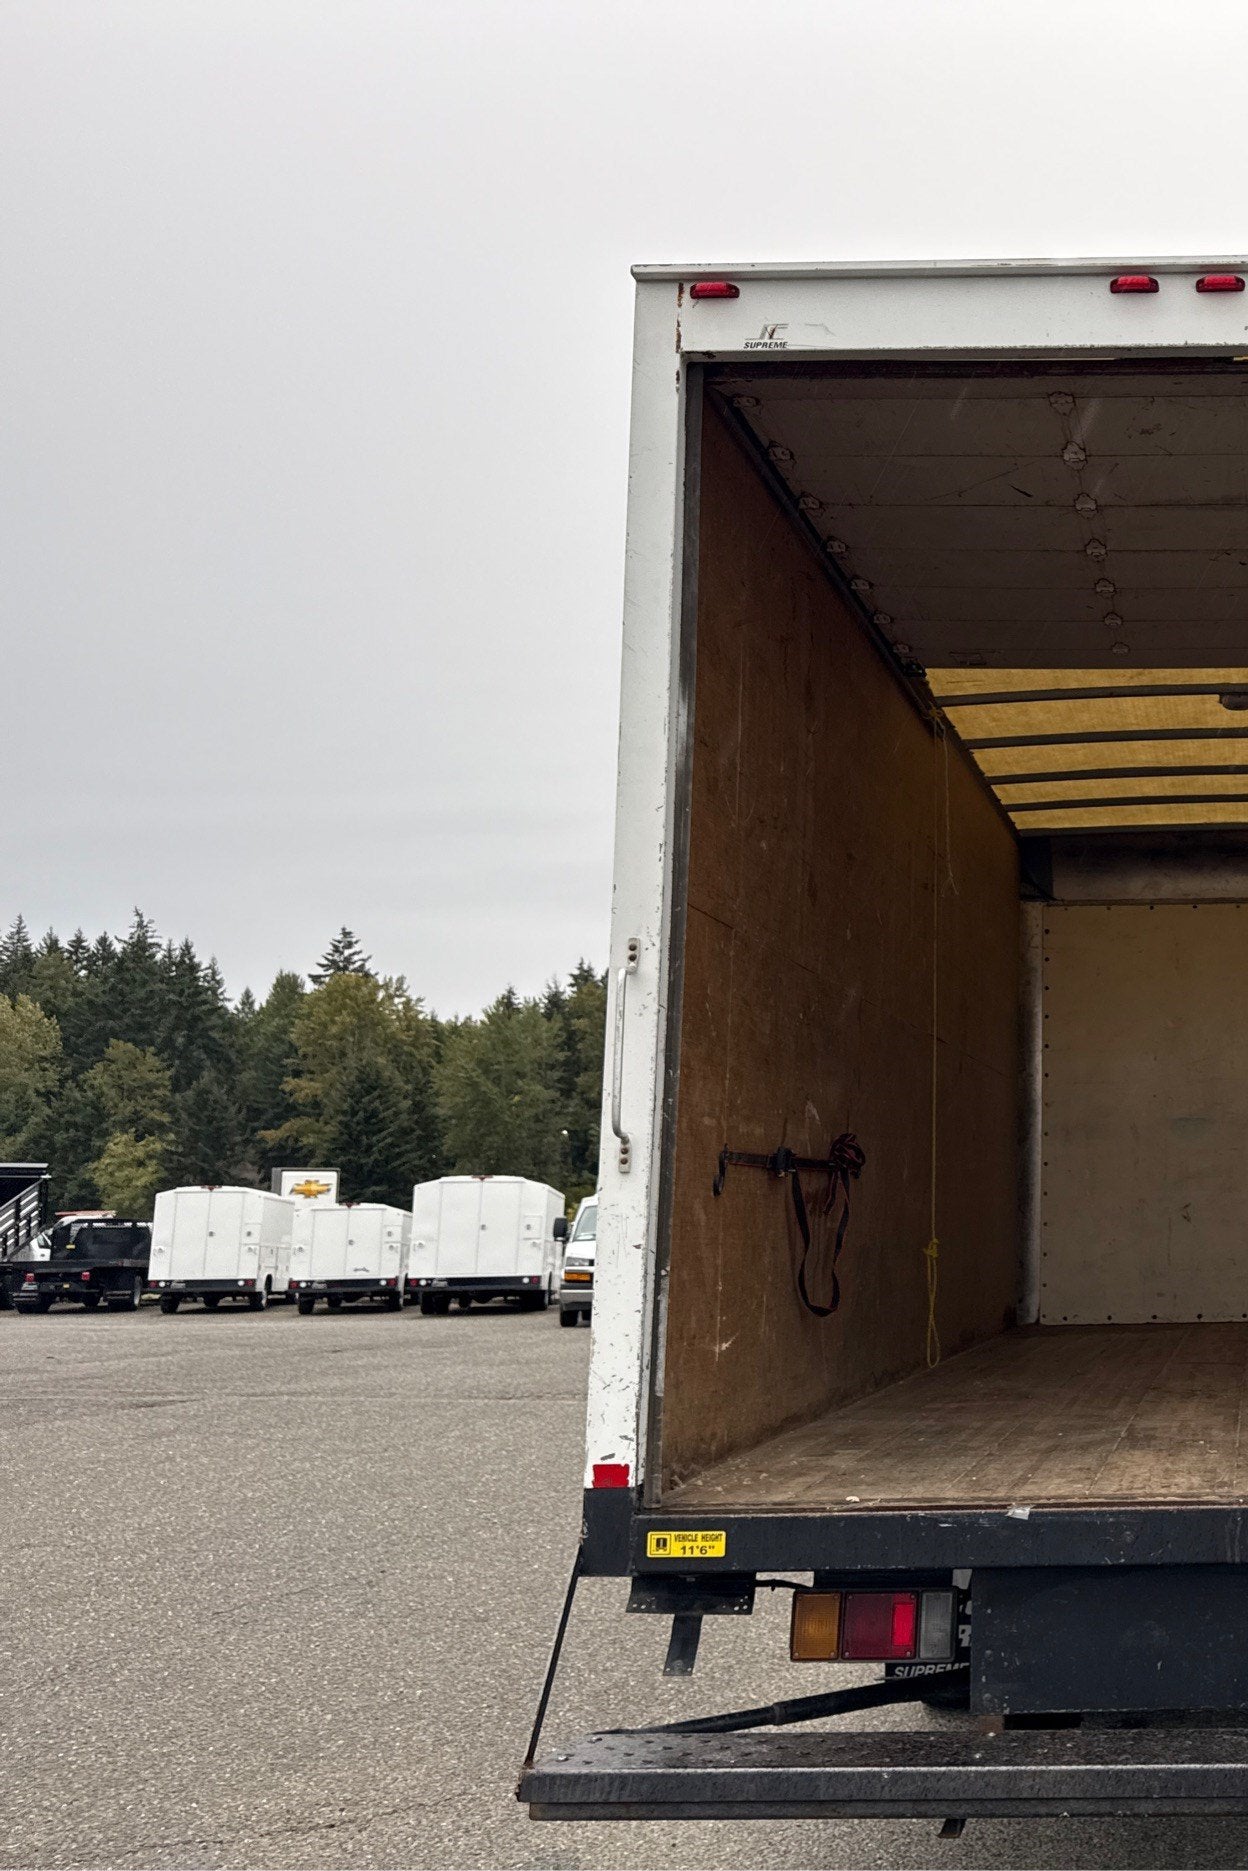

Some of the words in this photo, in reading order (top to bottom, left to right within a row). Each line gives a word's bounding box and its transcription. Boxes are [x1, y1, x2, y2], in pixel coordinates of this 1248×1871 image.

[743, 341, 788, 349] SUPREME
[674, 1533, 698, 1542] VEHICLE
[701, 1533, 723, 1542] HEIGHT
